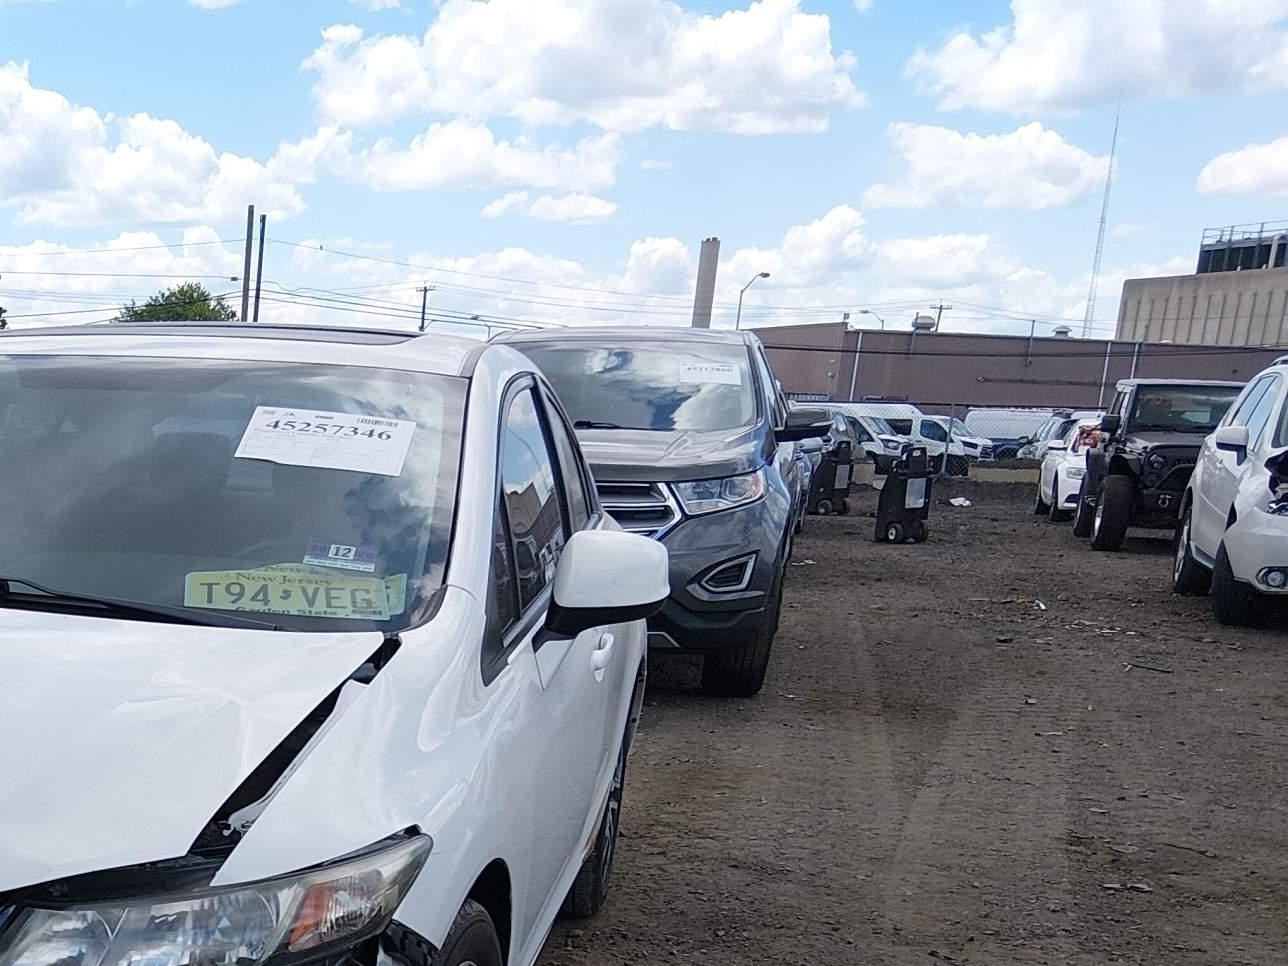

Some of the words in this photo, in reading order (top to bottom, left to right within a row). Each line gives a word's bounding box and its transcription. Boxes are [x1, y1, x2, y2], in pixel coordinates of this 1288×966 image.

[265, 419, 392, 441] 45257346
[333, 546, 352, 558] 12
[235, 572, 277, 583] New
[279, 575, 333, 586] Jersey
[199, 582, 271, 606] T94
